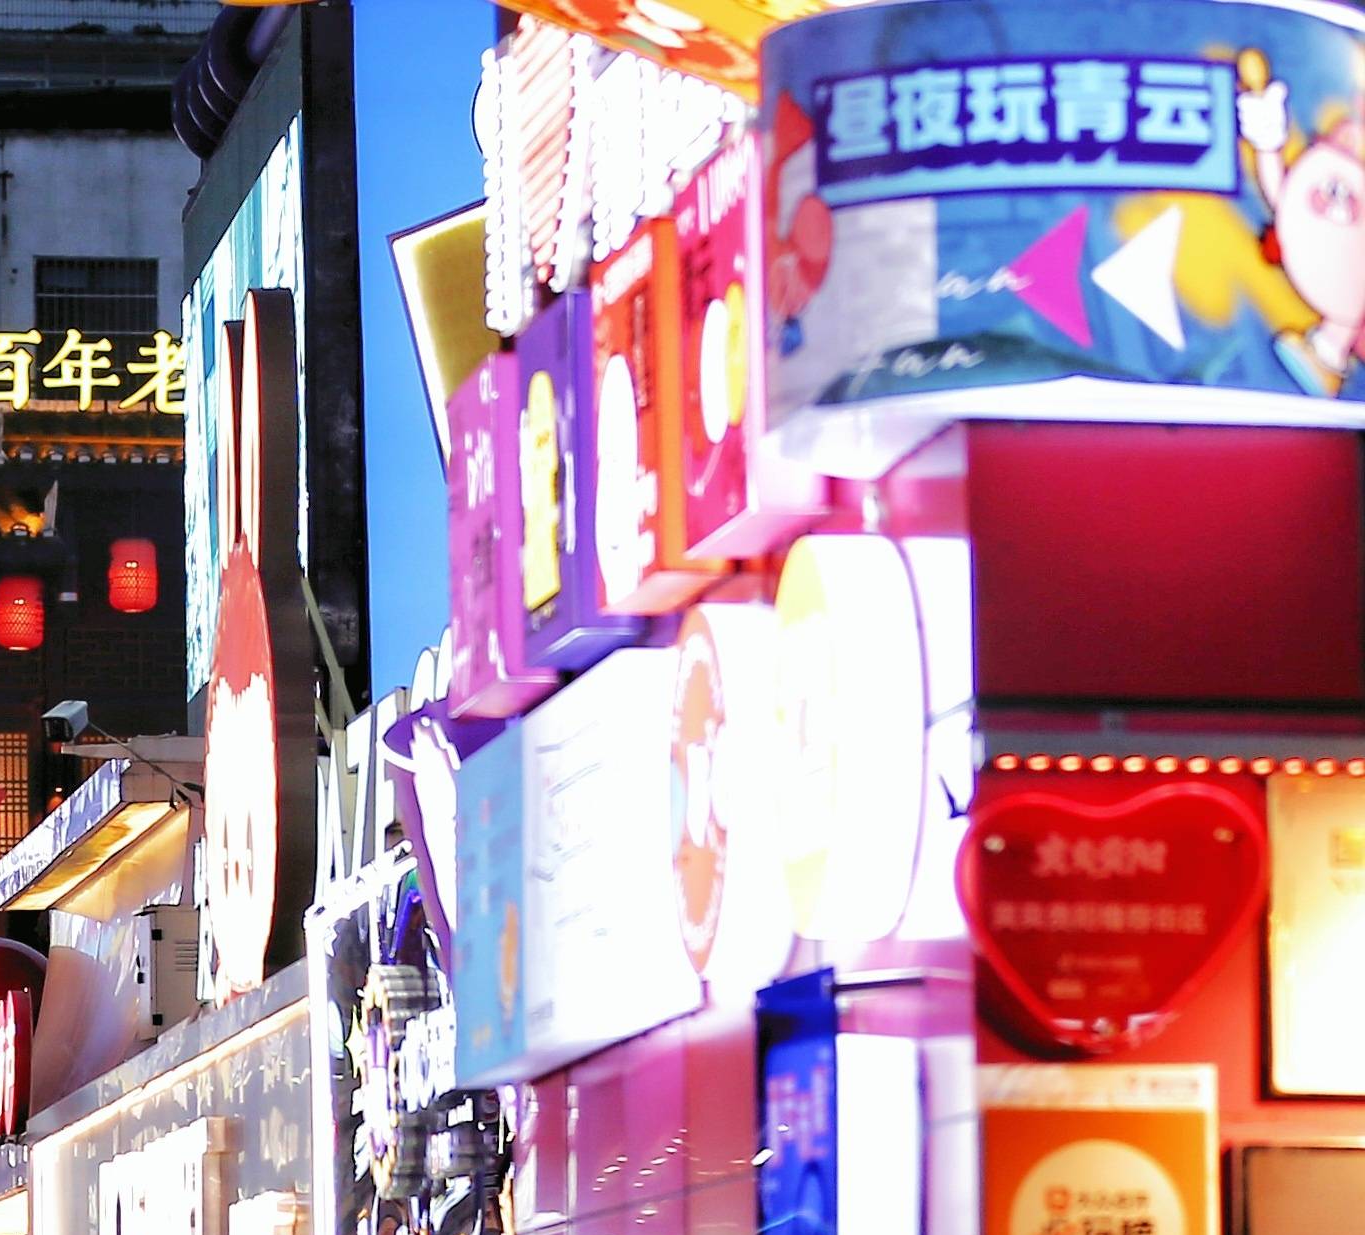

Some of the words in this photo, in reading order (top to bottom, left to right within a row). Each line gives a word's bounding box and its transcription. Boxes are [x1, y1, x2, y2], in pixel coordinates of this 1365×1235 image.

[828, 61, 1211, 160] 昼夜玩青云
